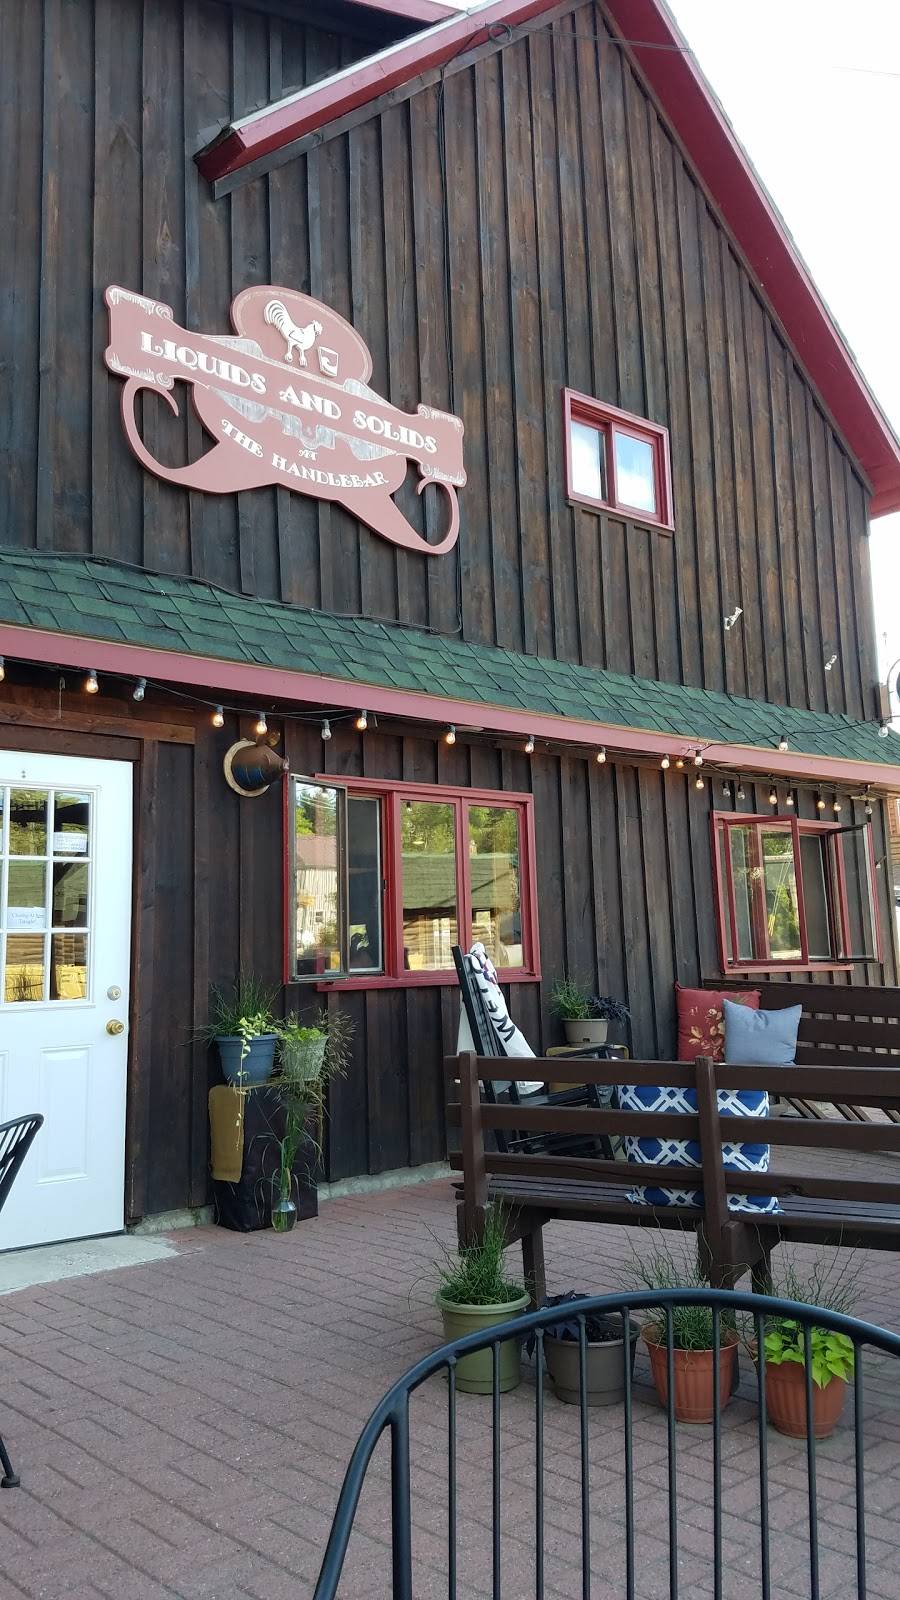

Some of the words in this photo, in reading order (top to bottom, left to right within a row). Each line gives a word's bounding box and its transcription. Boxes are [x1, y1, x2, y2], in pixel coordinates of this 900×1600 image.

[140, 331, 267, 395] LIQUIDS
[279, 385, 342, 420] AND
[353, 410, 438, 454] SOLIDS
[221, 419, 264, 458] THE
[271, 453, 390, 488] HANDLEBAR
